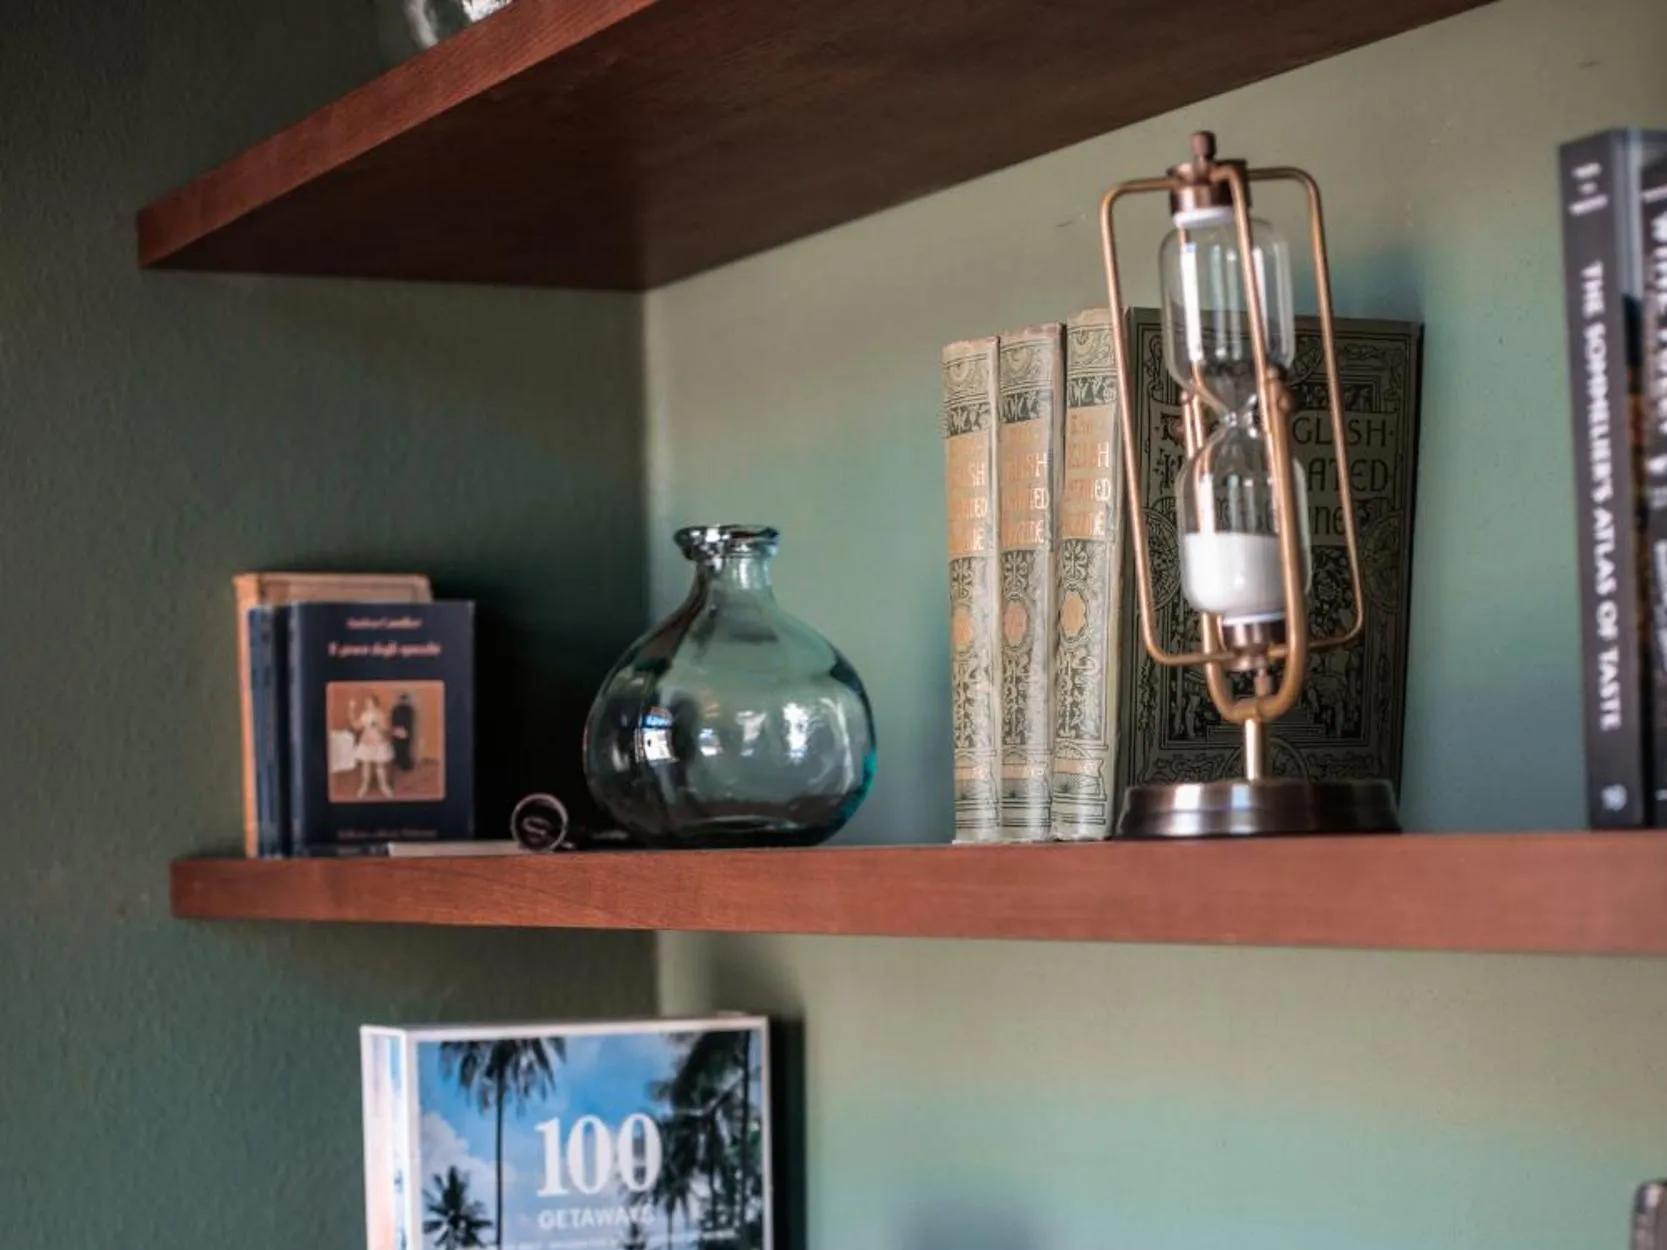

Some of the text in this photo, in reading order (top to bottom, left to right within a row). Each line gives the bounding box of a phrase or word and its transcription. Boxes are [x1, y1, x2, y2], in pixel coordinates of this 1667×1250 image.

[1592, 506, 1618, 597] ATLAS
[1596, 599, 1620, 641] OF
[1597, 644, 1623, 732] TASTE
[535, 1112, 664, 1198] 100
[536, 1203, 656, 1232] GETAWAYS
